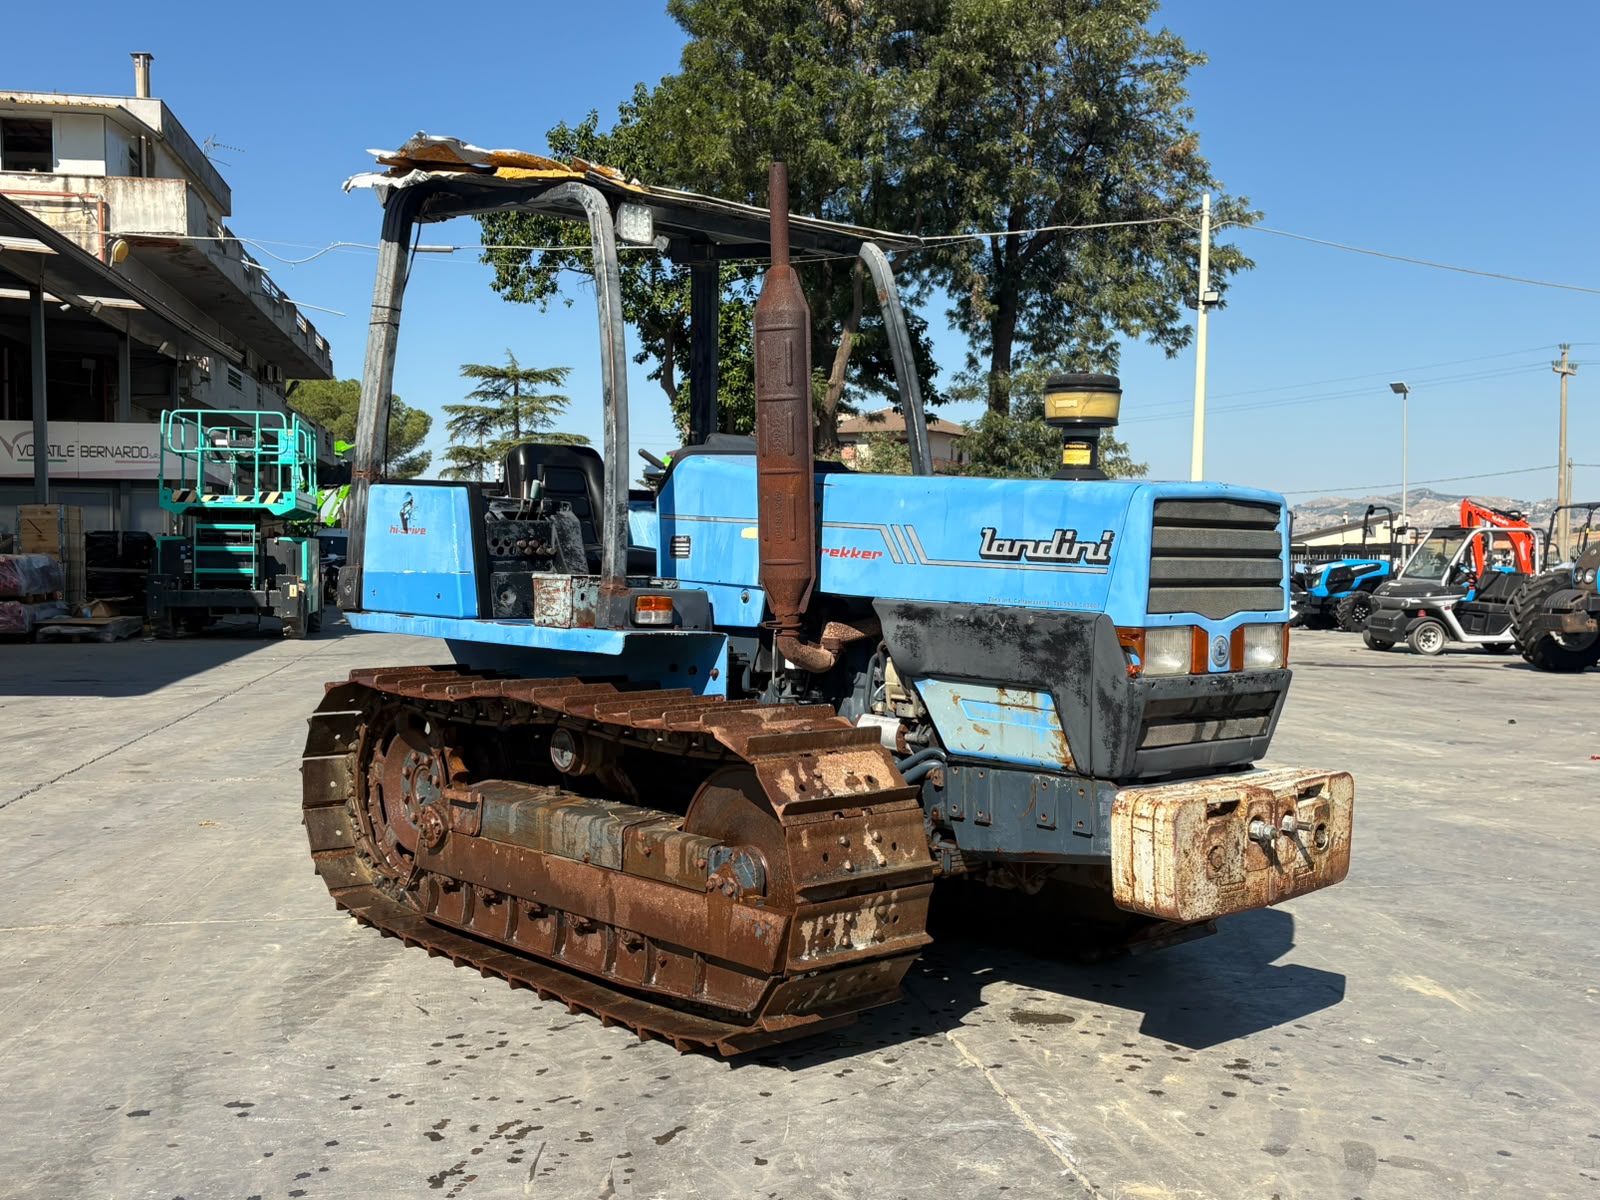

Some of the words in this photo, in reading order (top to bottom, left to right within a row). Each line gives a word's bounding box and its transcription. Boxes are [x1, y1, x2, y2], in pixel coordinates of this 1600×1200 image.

[17, 445, 75, 457] VOATILE
[80, 445, 149, 459] BERNARDO
[820, 546, 883, 560] rekker
